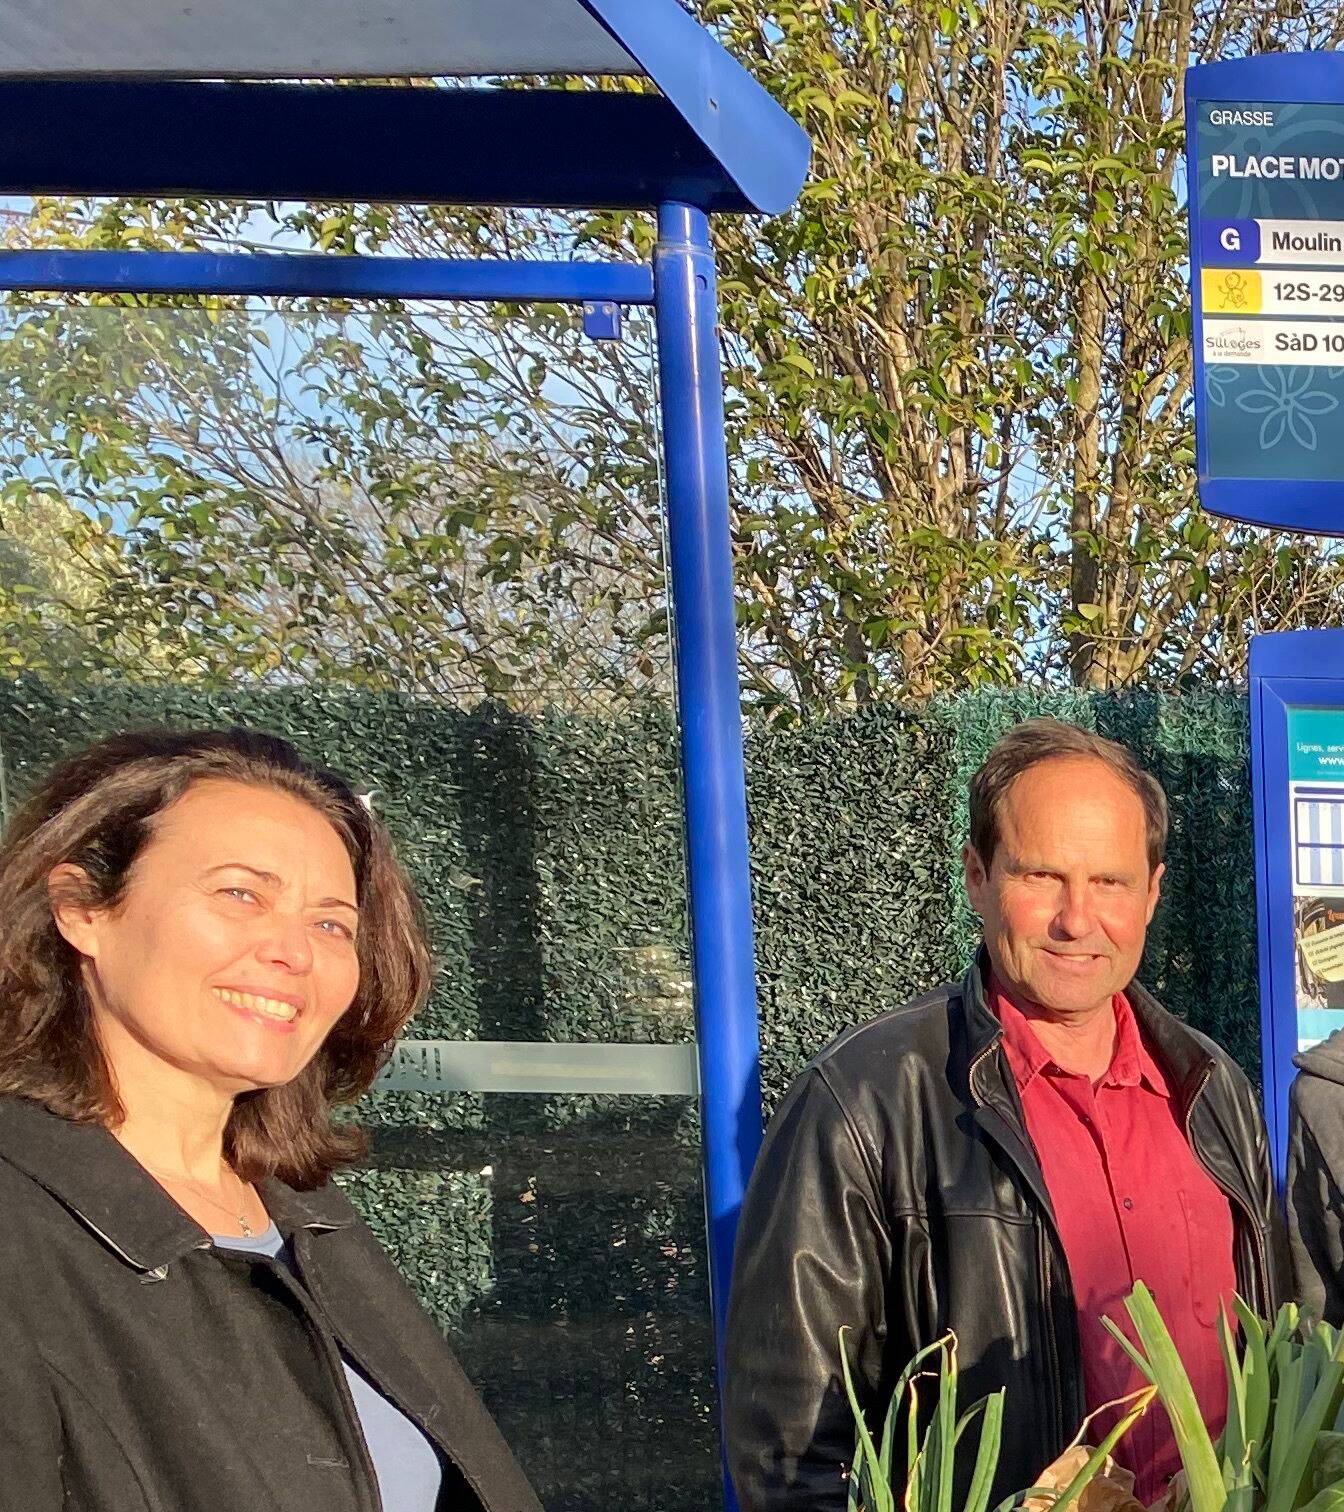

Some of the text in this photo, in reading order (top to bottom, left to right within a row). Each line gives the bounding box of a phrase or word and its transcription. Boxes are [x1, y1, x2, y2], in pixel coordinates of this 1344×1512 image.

[1209, 110, 1274, 127] GRASSE
[1211, 154, 1296, 179] PLACE
[1219, 226, 1241, 251] G
[1272, 231, 1342, 252] Moulin
[1275, 332, 1318, 352] SàD
